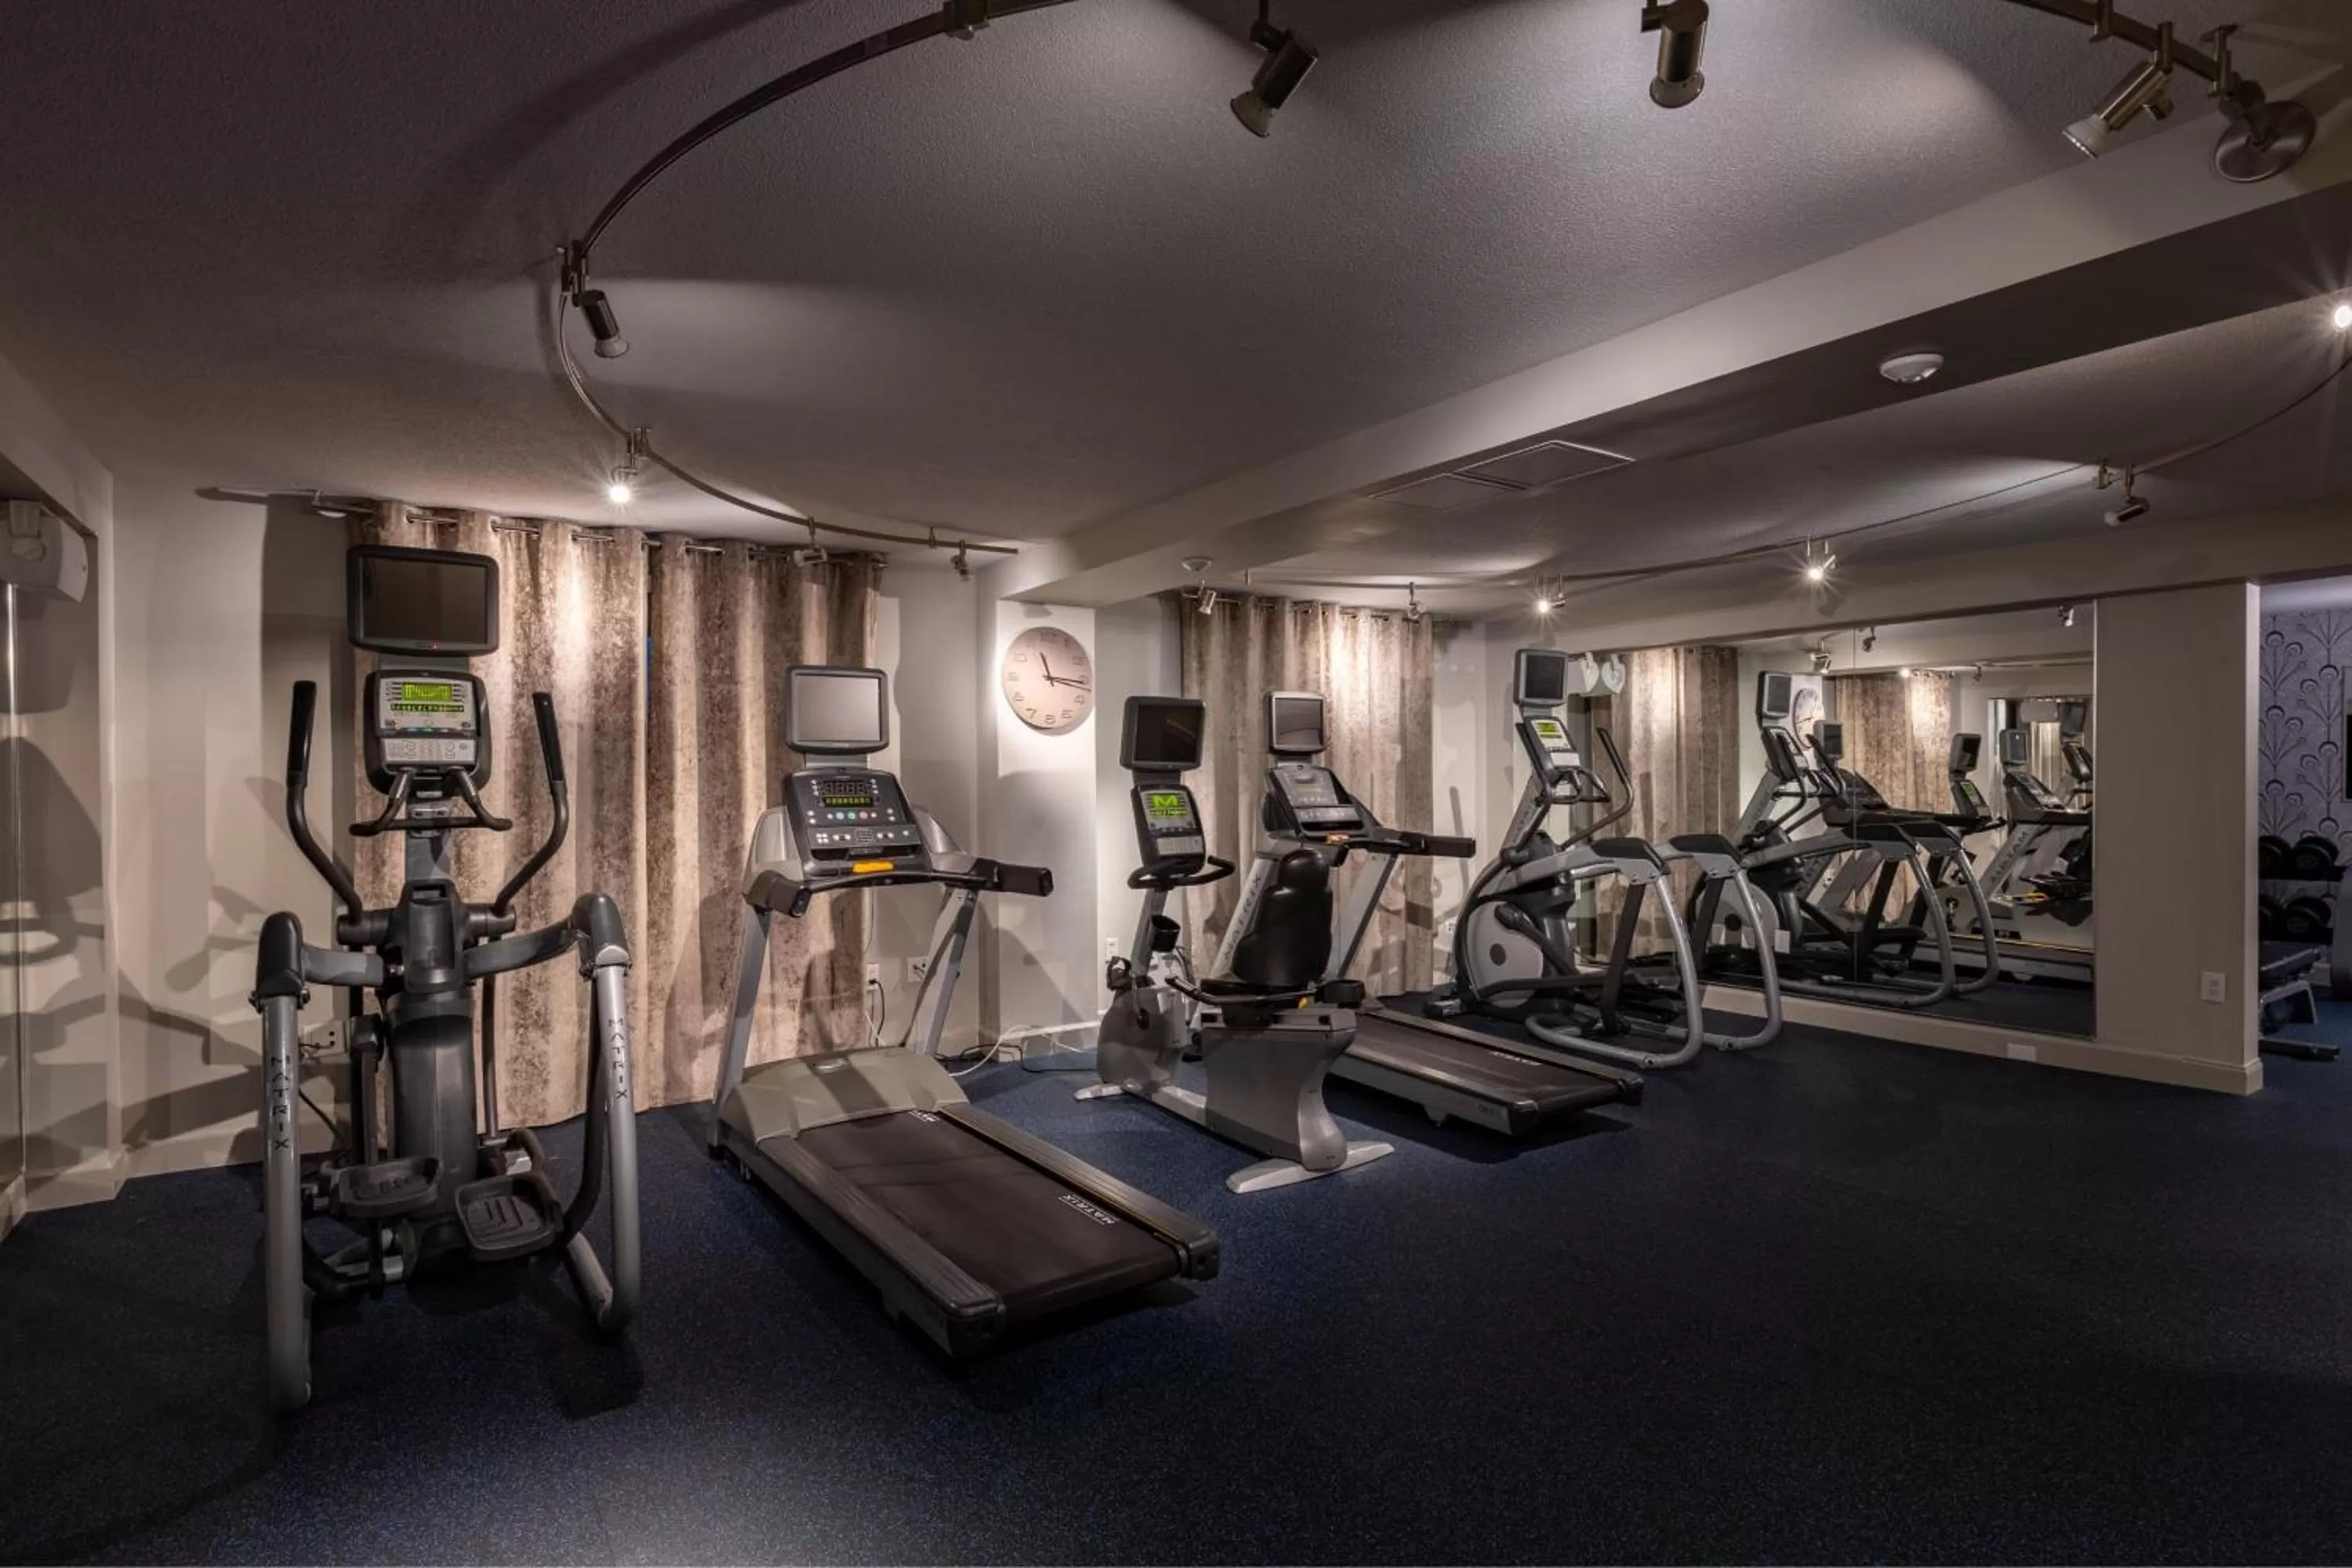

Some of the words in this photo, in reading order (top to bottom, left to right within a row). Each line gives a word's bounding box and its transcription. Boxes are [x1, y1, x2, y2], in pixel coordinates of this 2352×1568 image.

[608, 1018, 628, 1099] MATRIX
[270, 1054, 290, 1152] MATRIX
[1060, 1193, 1117, 1225] MATRIX
